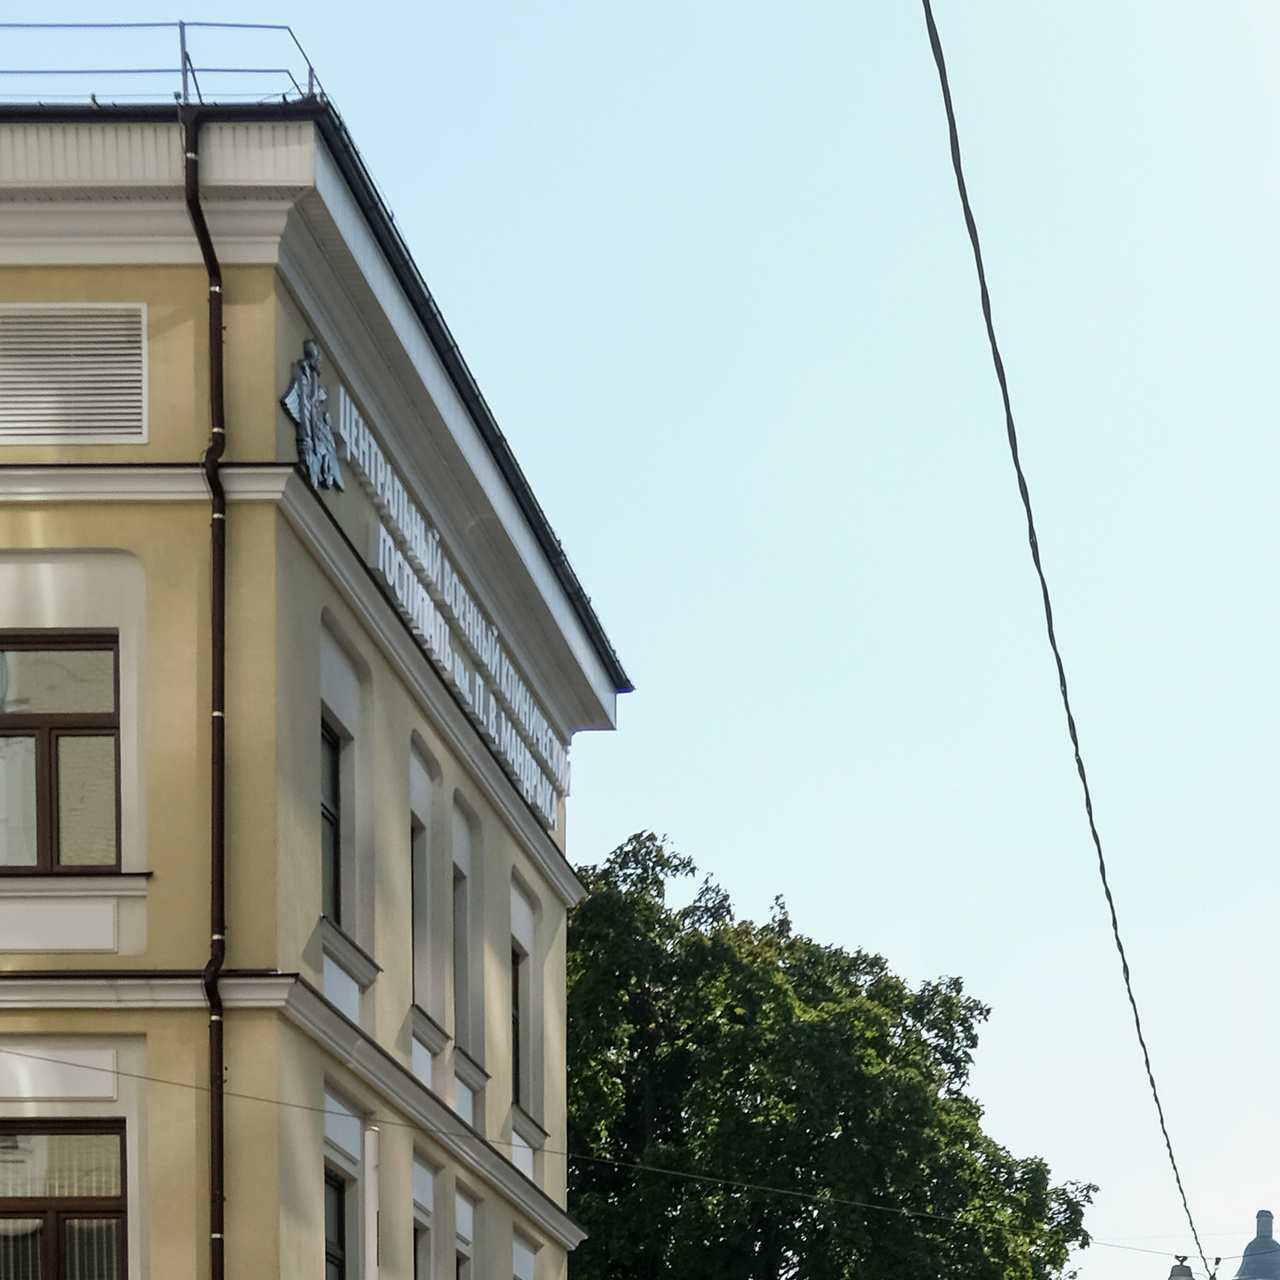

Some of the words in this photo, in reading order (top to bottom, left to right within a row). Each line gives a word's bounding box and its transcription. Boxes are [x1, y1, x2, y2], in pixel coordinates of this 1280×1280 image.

[338, 385, 442, 591] ЦЕНТРАЛЬНЫЙ
[444, 557, 500, 684] ВОЕННЫЙ
[501, 651, 571, 797] КЛИНИЧЕСКИЙ
[379, 522, 452, 672] ГОСПИТАЛЬ
[501, 710, 557, 831] МАНДРЫКА
